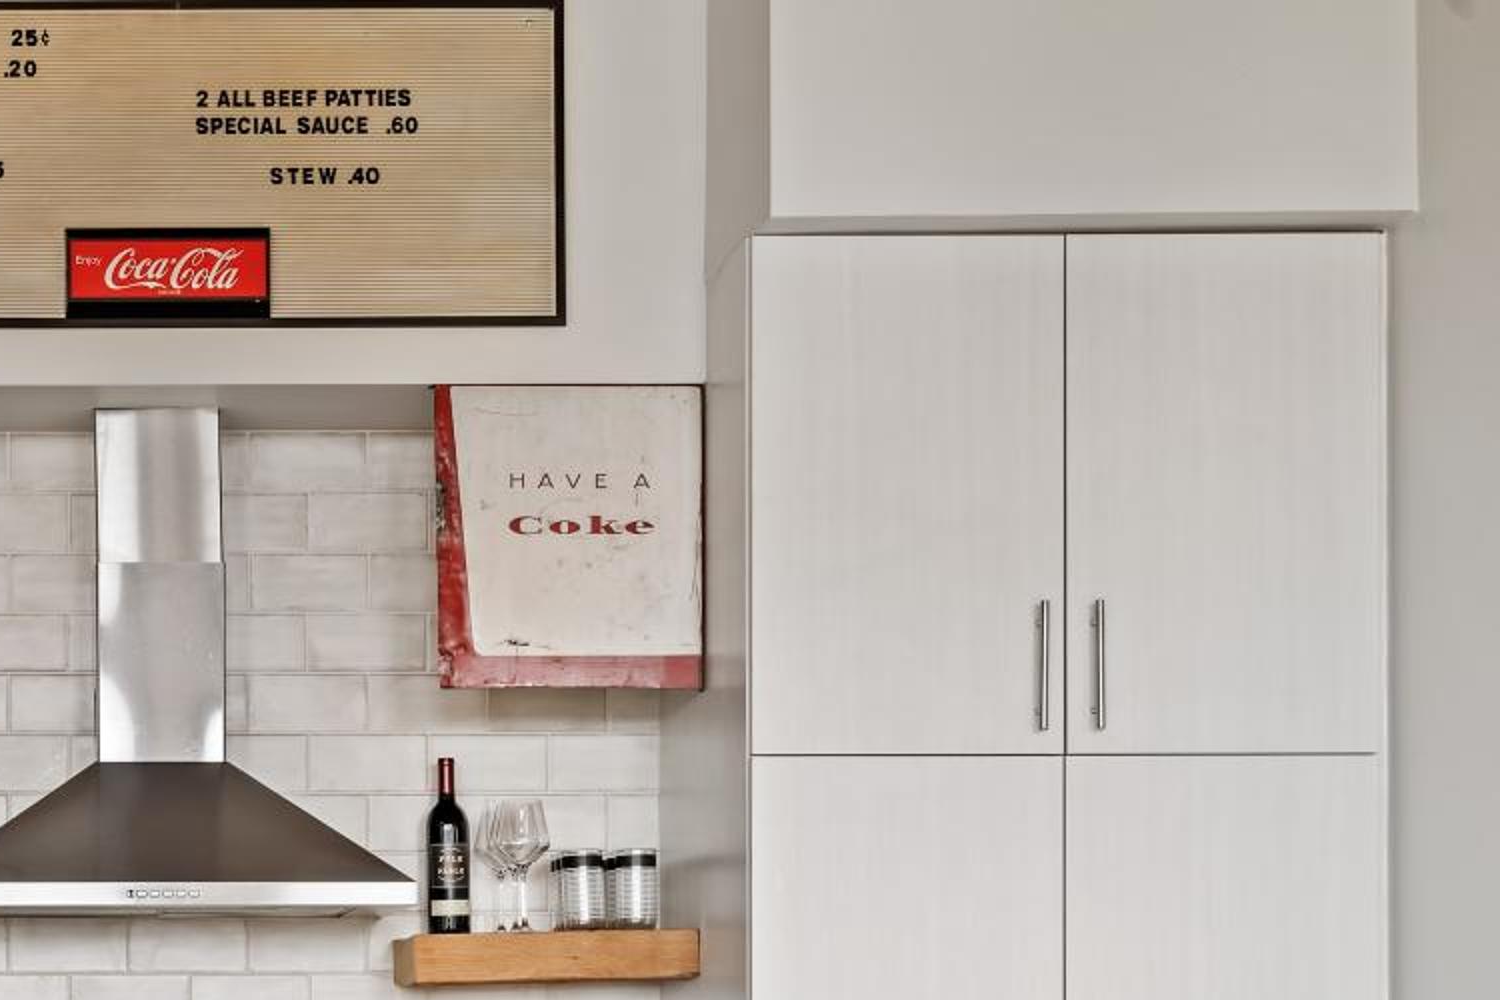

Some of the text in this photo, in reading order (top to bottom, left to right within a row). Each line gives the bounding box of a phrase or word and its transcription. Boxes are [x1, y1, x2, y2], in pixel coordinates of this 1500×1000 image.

[10, 28, 51, 48] 25¢
[3, 60, 38, 78] .20
[196, 88, 412, 108] 2 ALL BEEF PATTIES
[195, 115, 419, 136] SPECIAL SAUCE .60
[269, 166, 381, 186] STEW .40
[75, 247, 245, 290] Enjoy Coca-Cola
[508, 472, 651, 489] HAVE A
[508, 514, 655, 536] Coke
